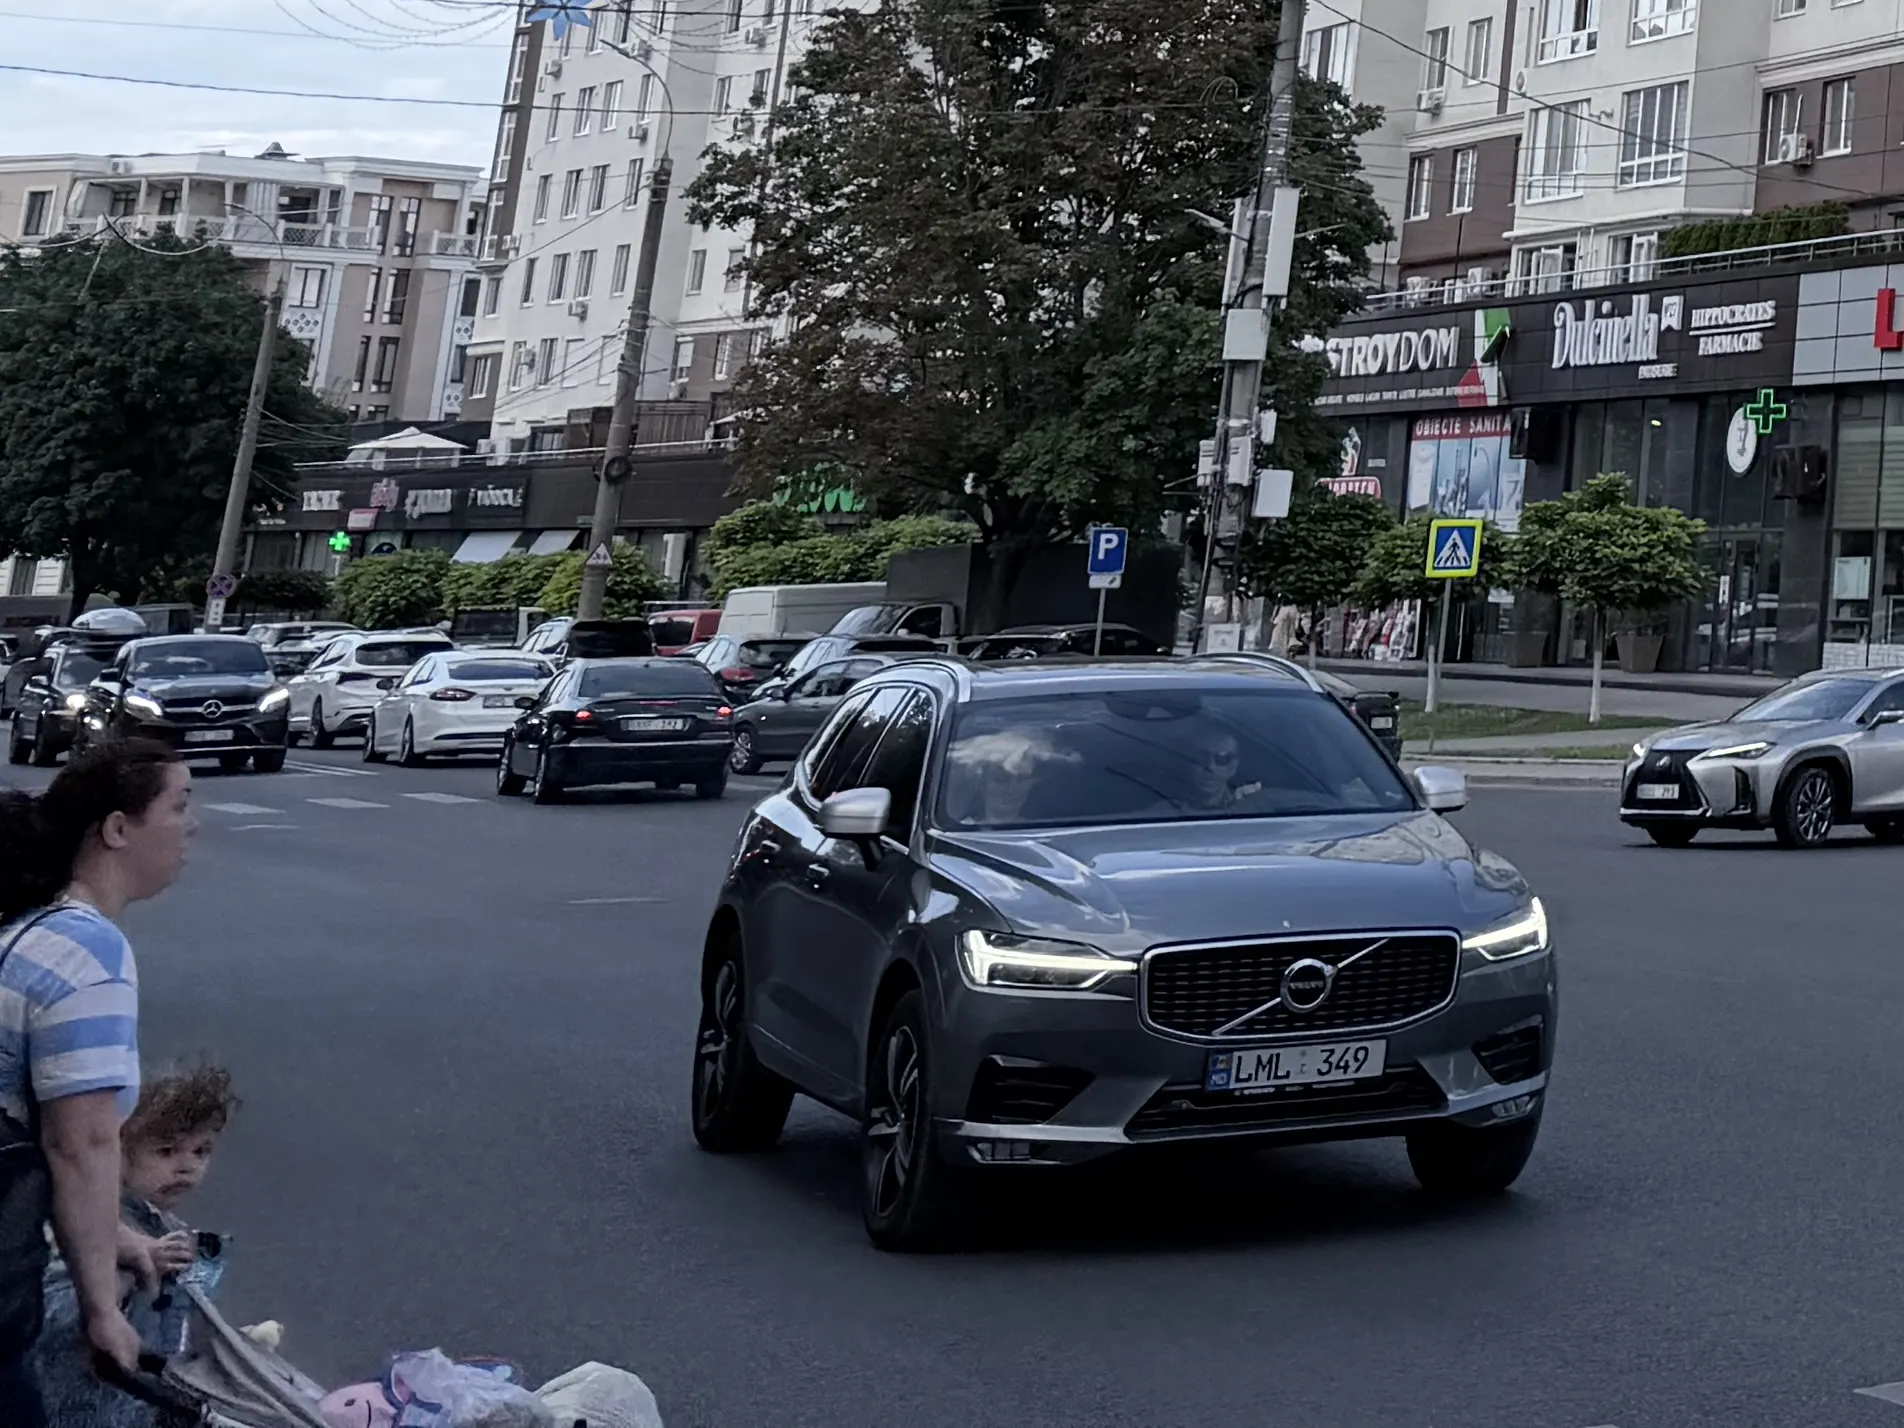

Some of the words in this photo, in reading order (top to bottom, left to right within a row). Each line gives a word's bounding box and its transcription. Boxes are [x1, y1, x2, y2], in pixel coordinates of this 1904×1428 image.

[1690, 300, 1776, 328] HIPPOCRATES
[1551, 294, 1660, 369] Dulcinella
[1698, 331, 1764, 356] FARMACIE
[1415, 415, 1461, 436] OBIECTE
[1469, 413, 1512, 434] SANITA
[1098, 533, 1119, 560] P
[1234, 1052, 1290, 1083] LML
[1316, 1045, 1369, 1077] 349
